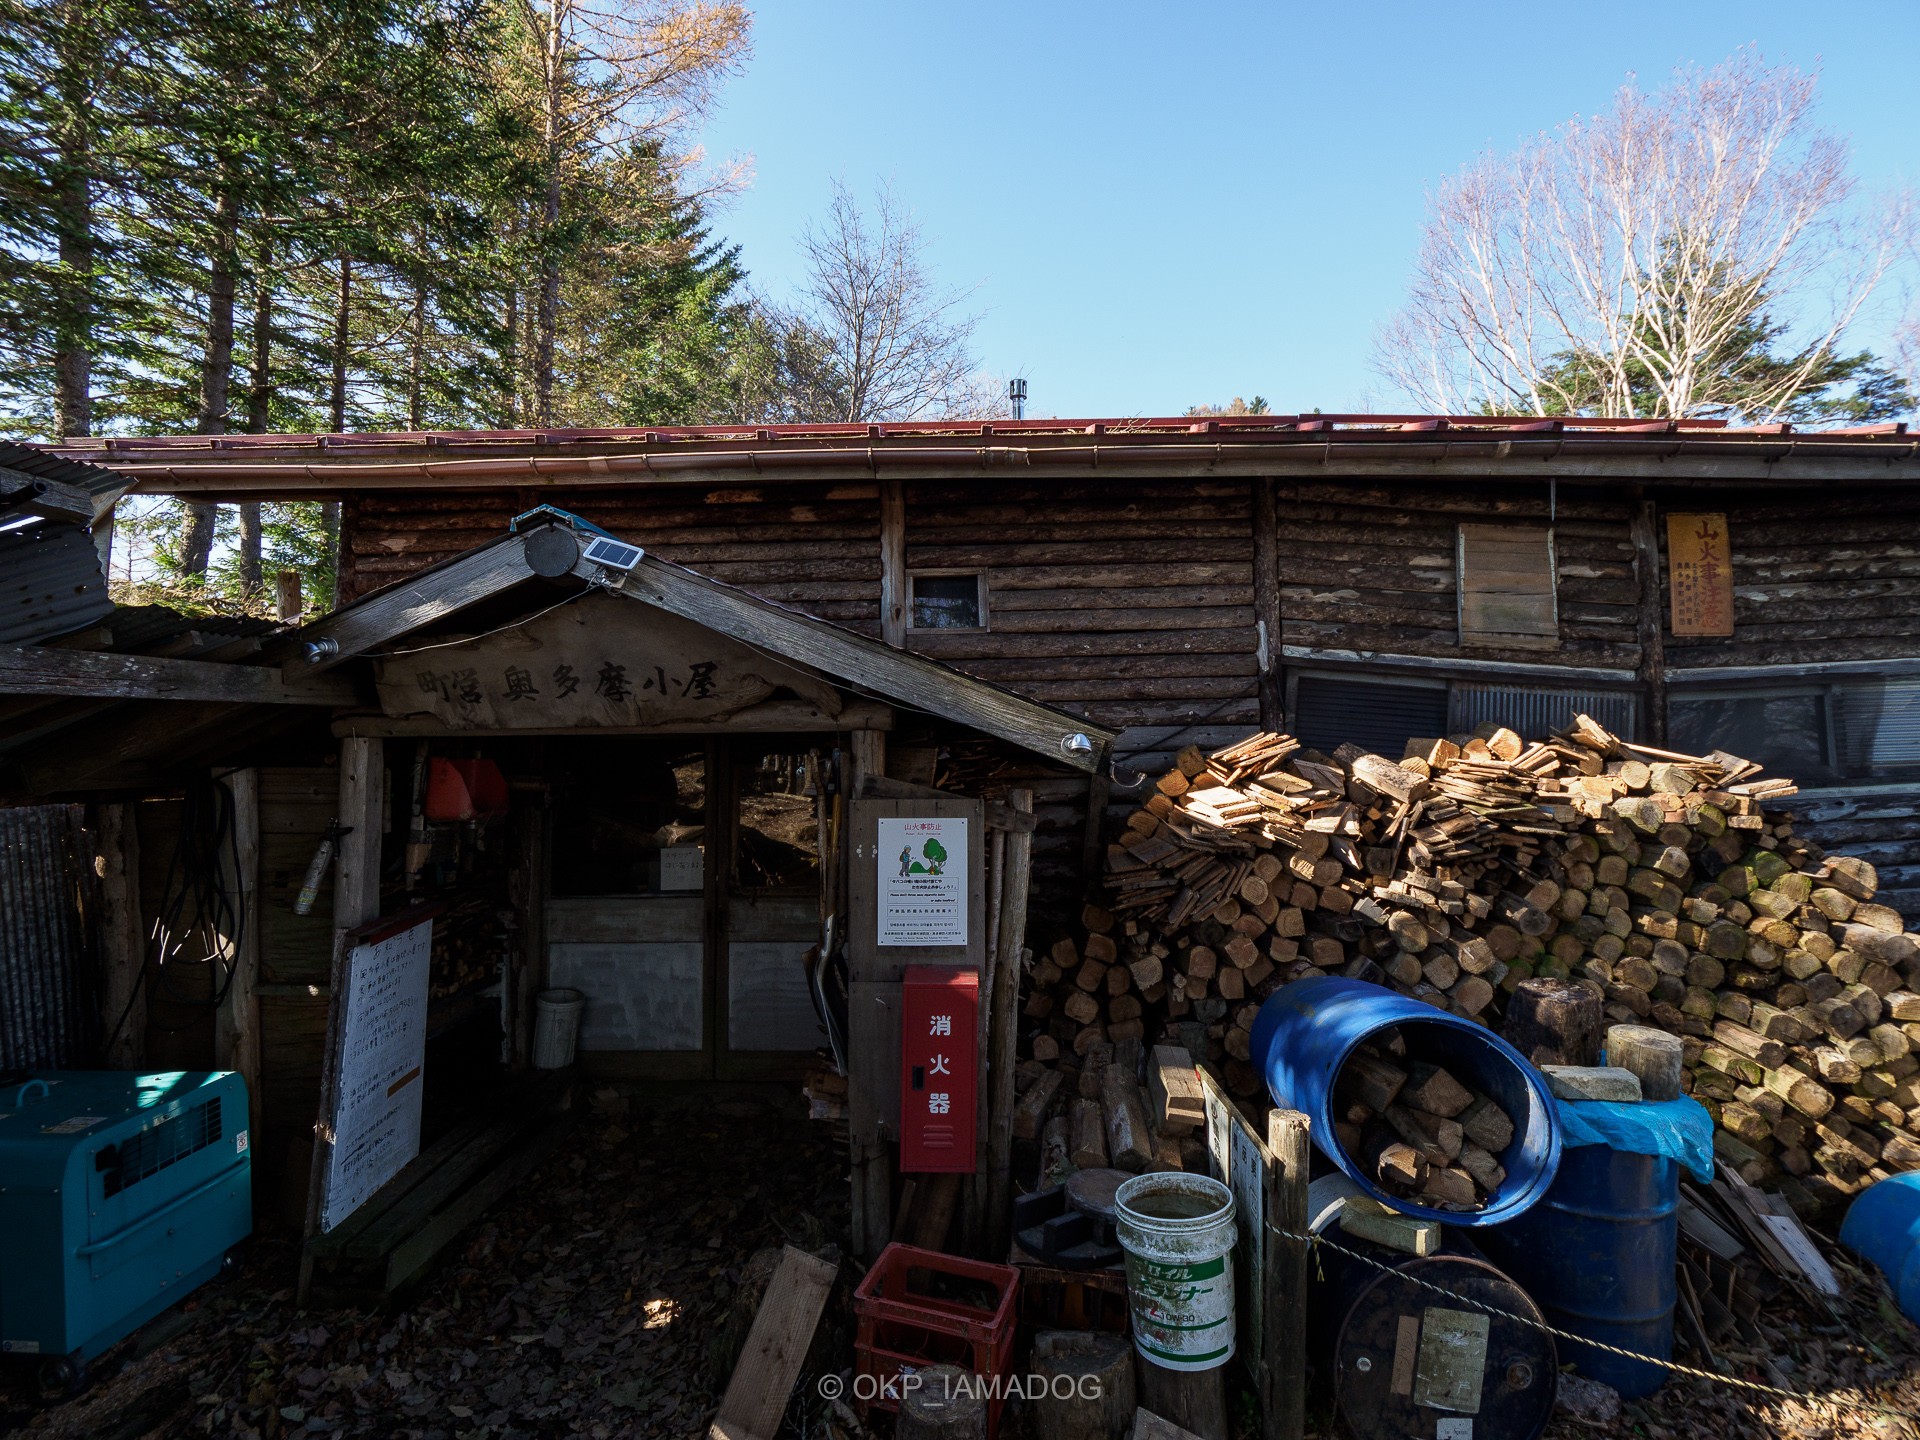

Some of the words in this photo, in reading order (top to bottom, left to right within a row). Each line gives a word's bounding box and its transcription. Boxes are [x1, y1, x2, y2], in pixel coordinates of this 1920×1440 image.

[904, 822, 942, 831] 山火事防止
[928, 1014, 952, 1114] 消火器
